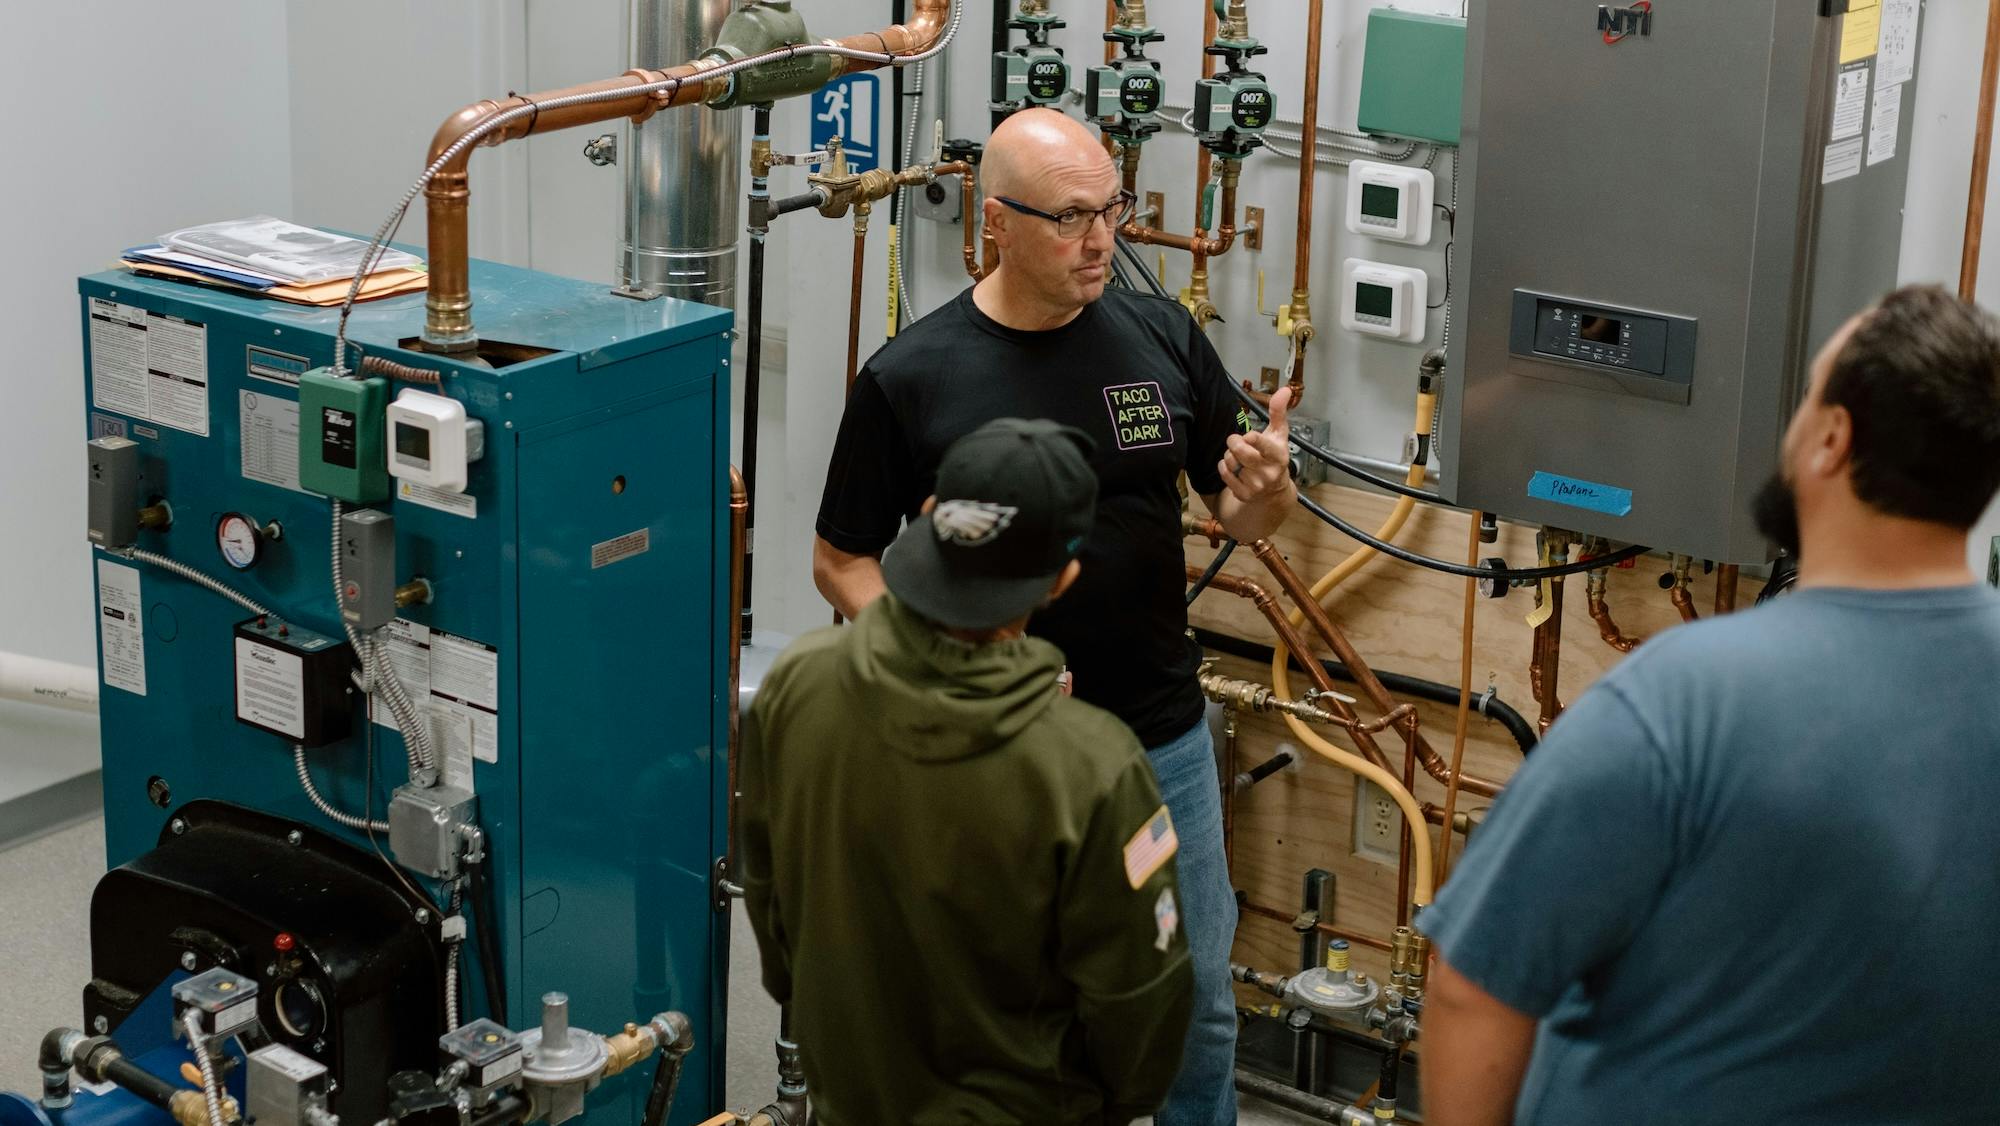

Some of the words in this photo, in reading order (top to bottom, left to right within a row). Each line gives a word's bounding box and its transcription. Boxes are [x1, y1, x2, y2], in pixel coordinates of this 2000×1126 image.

[1598, 5, 1652, 36] NTI
[1110, 388, 1150, 405] TACO
[1118, 405, 1165, 425] AFTER
[1121, 424, 1161, 442] DARK
